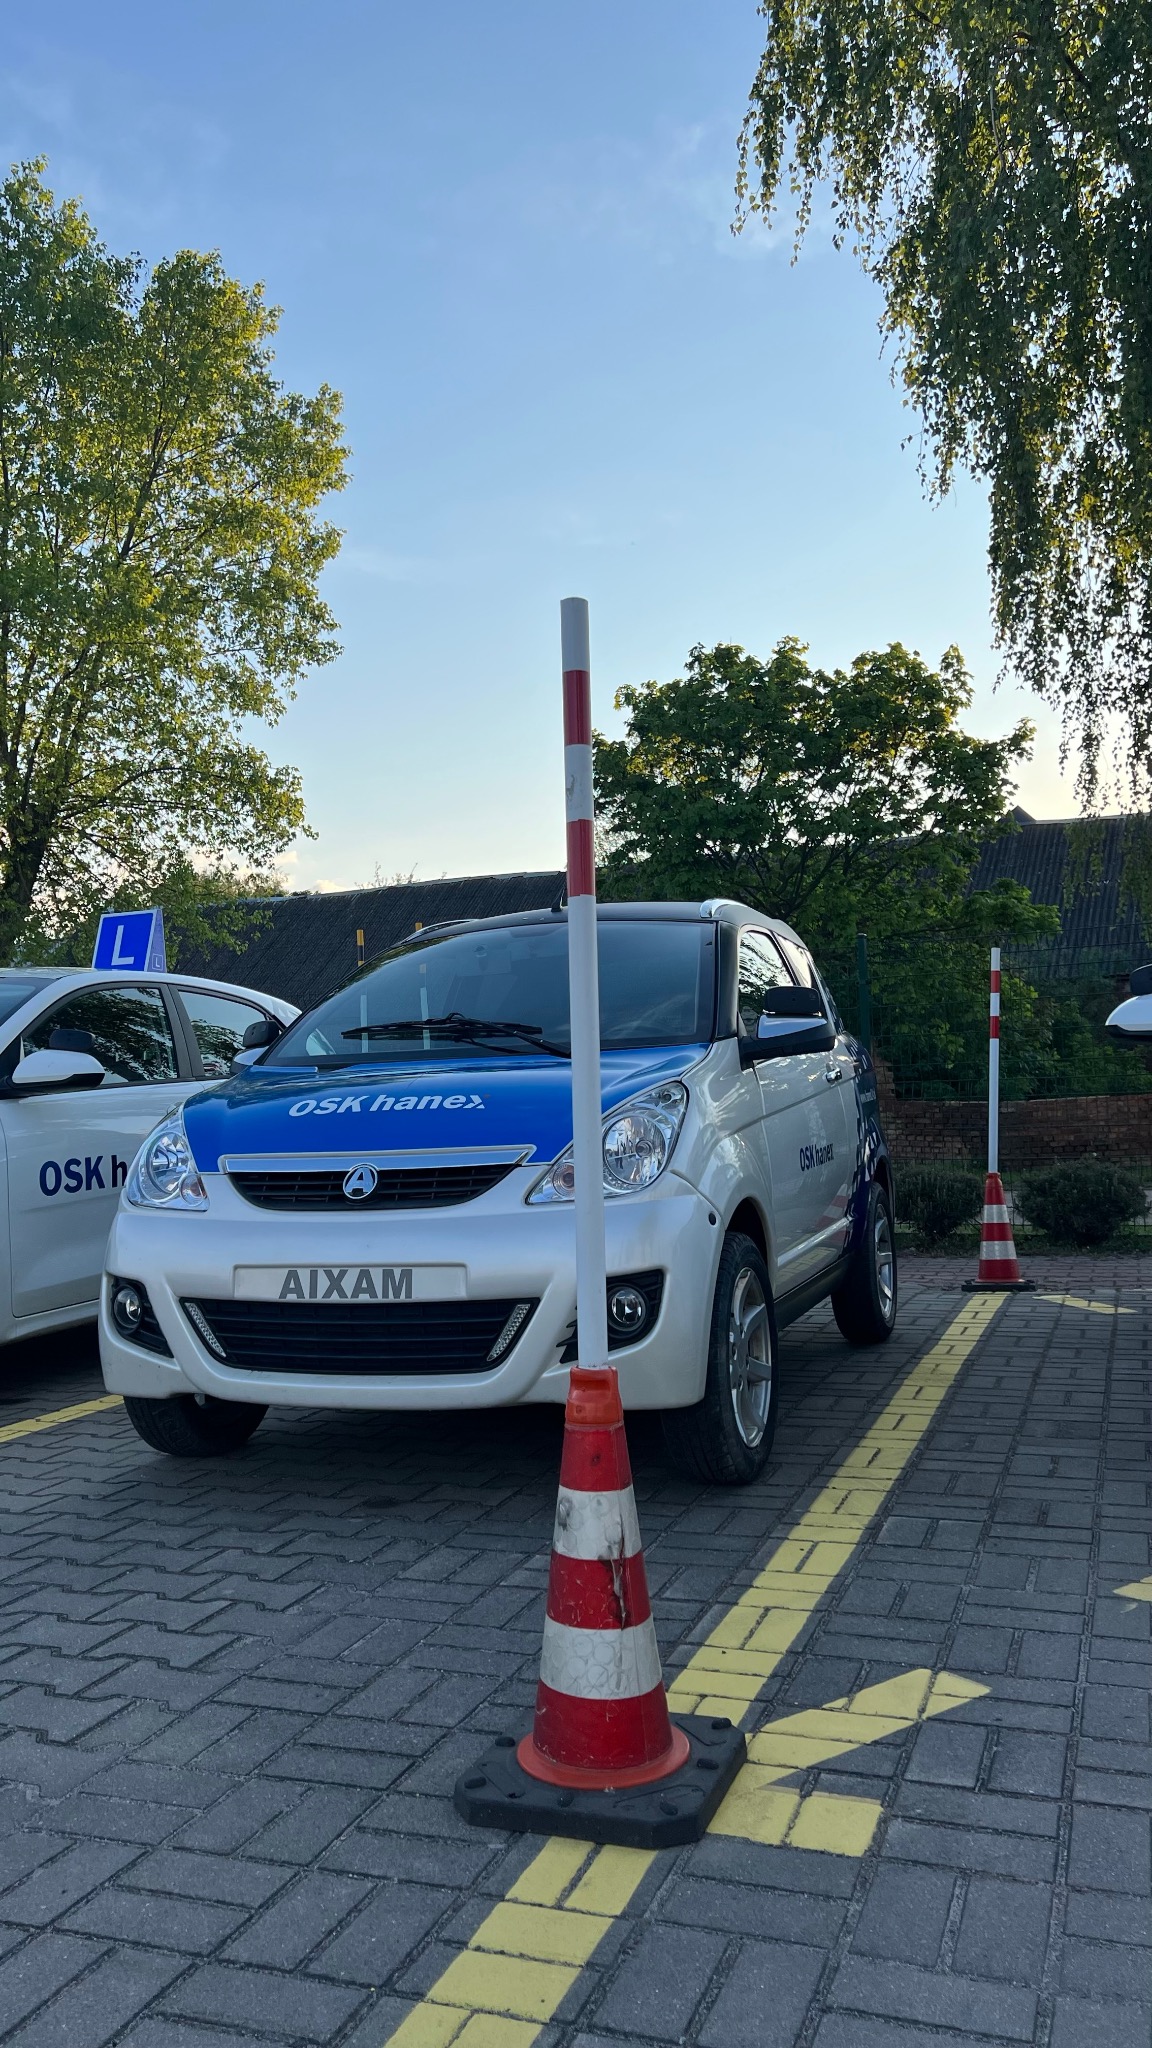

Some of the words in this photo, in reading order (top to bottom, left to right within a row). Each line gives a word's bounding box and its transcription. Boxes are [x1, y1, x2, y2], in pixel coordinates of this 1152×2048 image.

[111, 925, 134, 966] L
[289, 1095, 370, 1117] OSK
[369, 1094, 485, 1112] hanex
[800, 1144, 816, 1172] OSK
[815, 1143, 834, 1167] hanex
[39, 1155, 105, 1197] OSK
[278, 1269, 413, 1300] AIXAM
